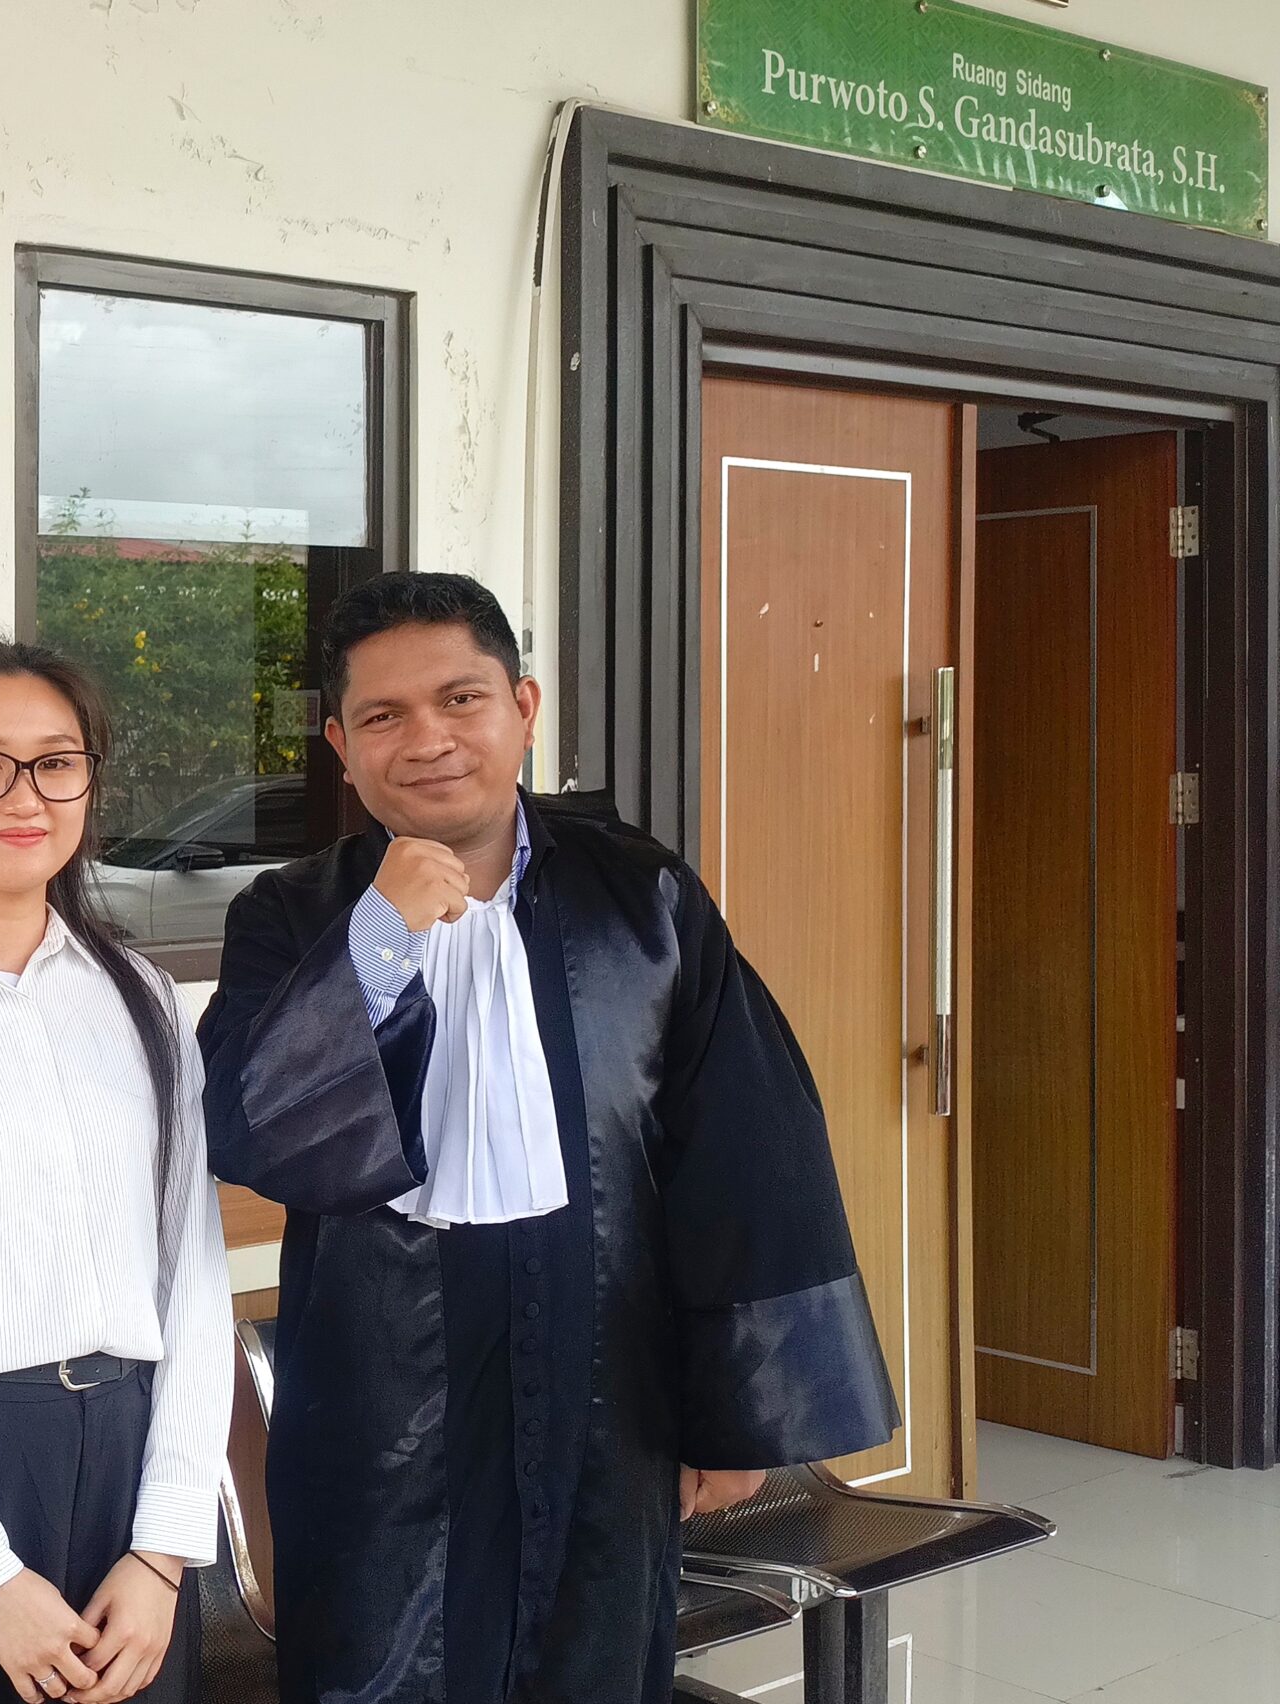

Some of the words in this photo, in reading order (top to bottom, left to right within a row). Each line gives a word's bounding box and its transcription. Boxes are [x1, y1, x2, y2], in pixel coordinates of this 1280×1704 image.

[761, 48, 908, 123] Purwoto
[918, 86, 944, 131] S.
[954, 96, 1165, 184] Gandasubrata,
[1172, 146, 1226, 193] S.H.
[952, 53, 1007, 95] Ruang
[1016, 69, 1072, 112] Sidang
